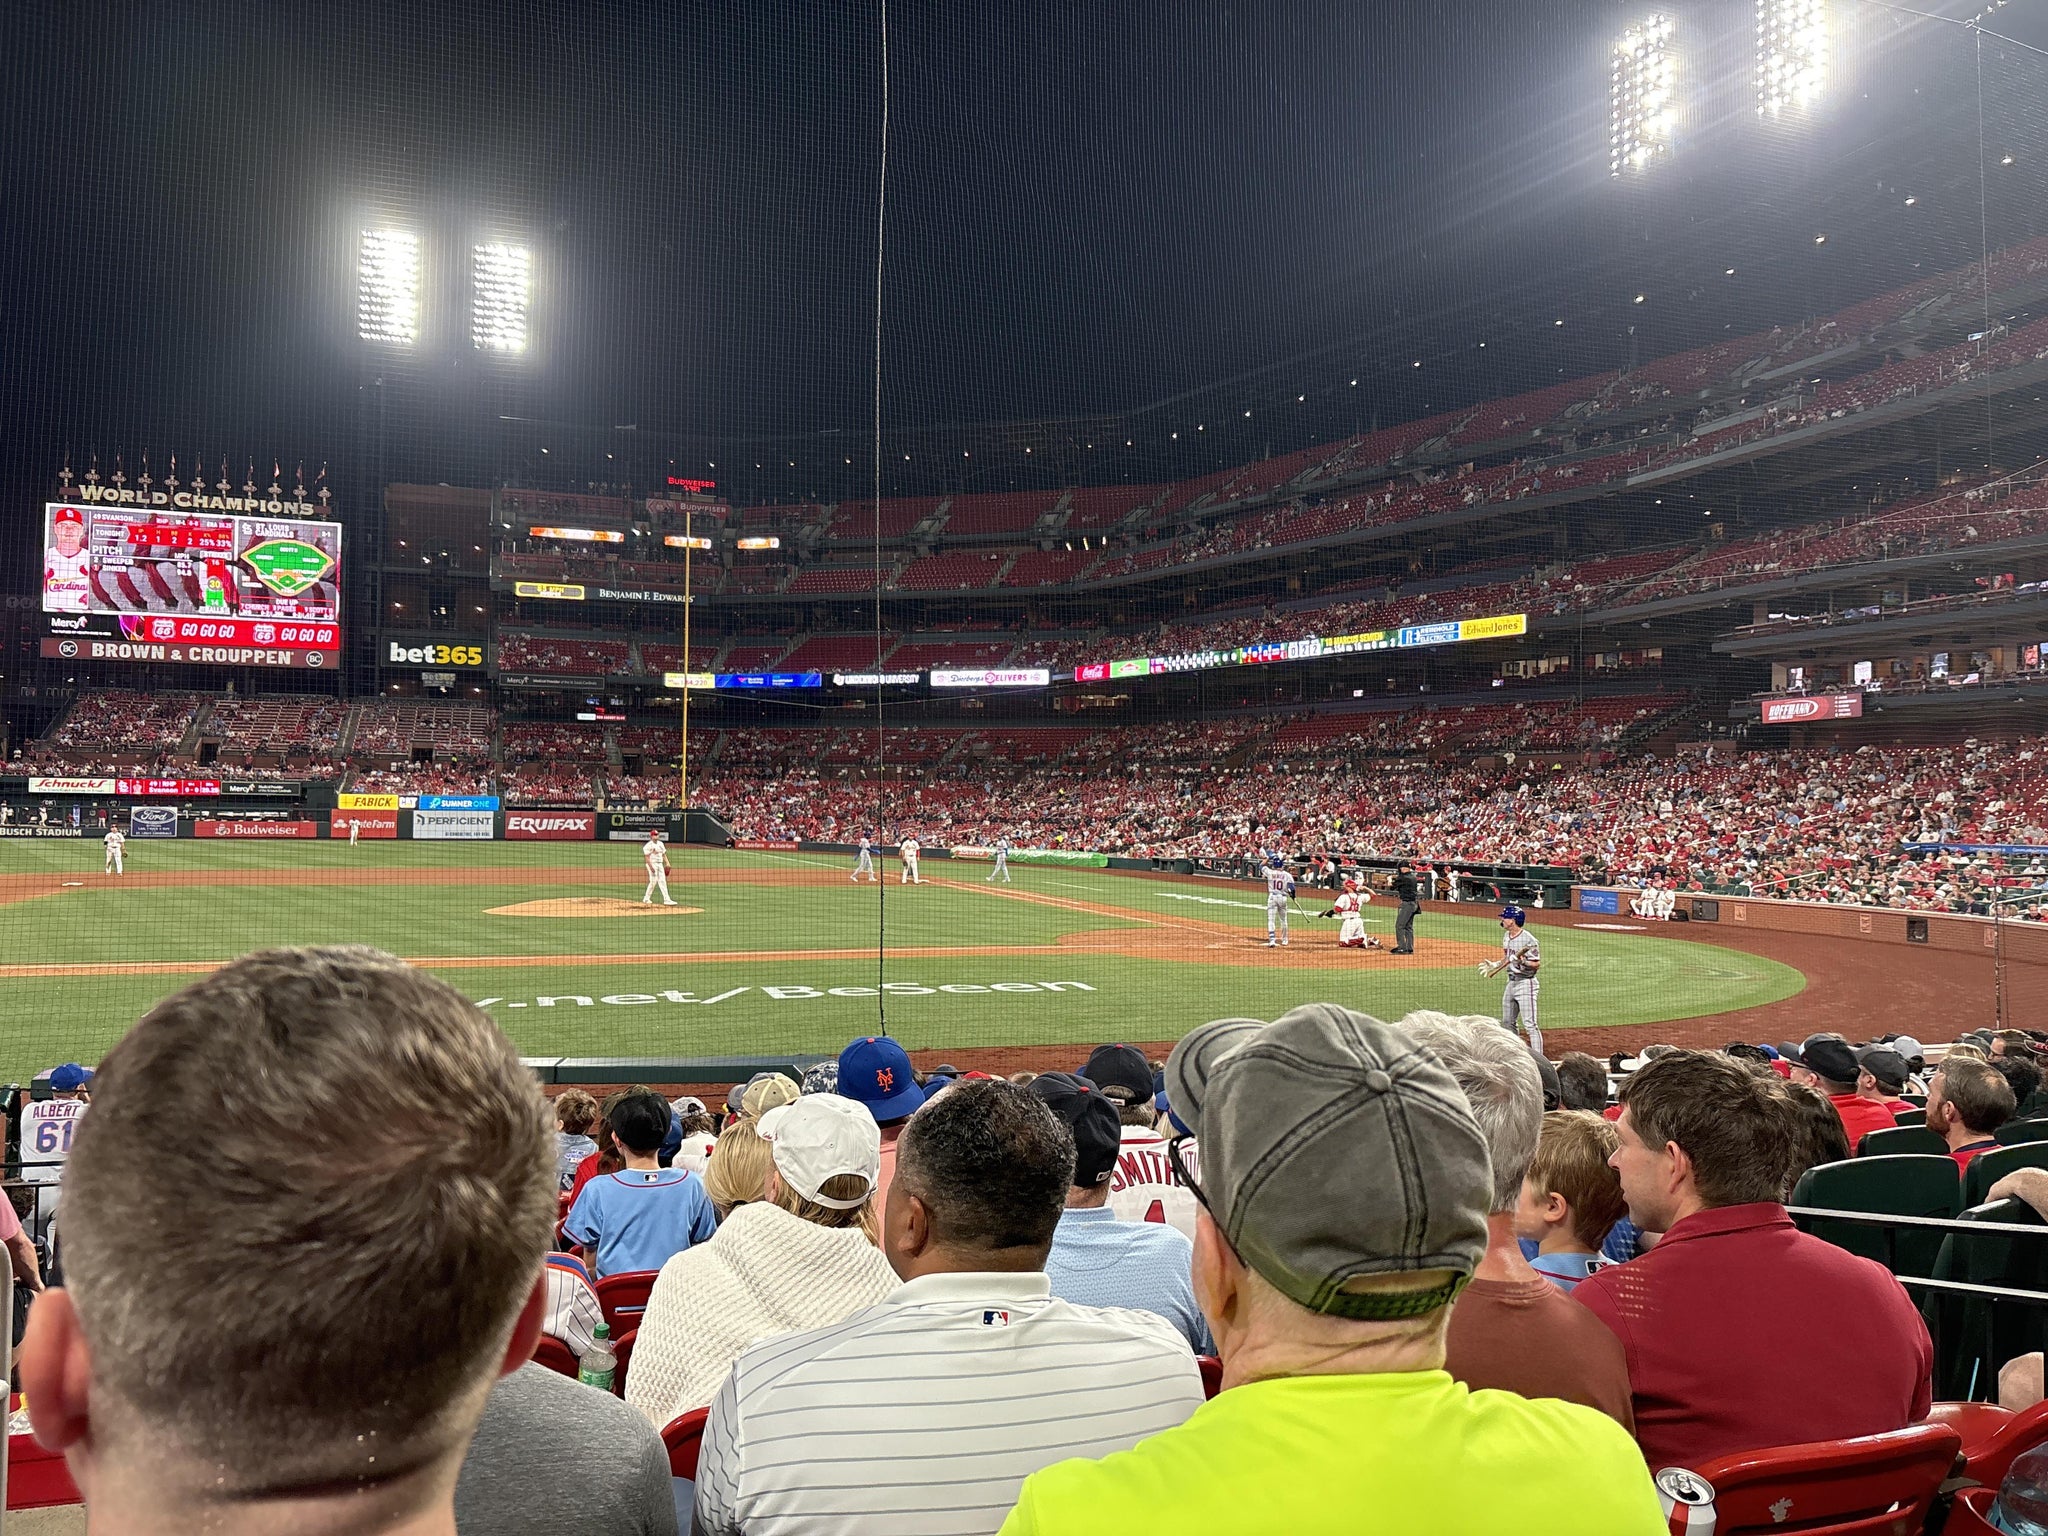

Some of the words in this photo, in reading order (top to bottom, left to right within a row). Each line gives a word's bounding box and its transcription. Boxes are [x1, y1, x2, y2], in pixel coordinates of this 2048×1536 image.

[667, 476, 716, 488] BUDWEISER
[78, 484, 168, 504] WORLD
[173, 492, 315, 516] CHAMPIONS
[680, 502, 727, 514] BUDWEISER
[95, 528, 125, 537] TONIGHT
[268, 523, 290, 532] LOUIS
[255, 529, 294, 539] CARDINALS
[134, 534, 148, 543] 1.2
[155, 535, 161, 543] 1
[171, 536, 178, 545] 2
[187, 537, 193, 545] 2
[199, 538, 216, 547] 25%
[215, 539, 232, 548] 33%
[92, 545, 123, 556] PITCH
[102, 556, 134, 565] SWEEPER
[209, 580, 221, 589] 30
[600, 588, 642, 600] BENJAMIN
[643, 592, 651, 600] F.
[51, 617, 79, 630] Mercy
[156, 628, 171, 636] 66
[181, 623, 198, 637] GO
[200, 624, 216, 638] GO
[218, 625, 235, 639] GO
[281, 628, 297, 641] GO
[299, 629, 314, 642] GO
[316, 629, 332, 643] GO
[62, 644, 76, 653] BC
[91, 642, 165, 660] BROWN
[171, 650, 182, 661] &
[189, 647, 292, 665] CROUPPEN
[389, 641, 483, 666] bet365
[1302, 645, 1307, 655] 2
[1312, 644, 1318, 655] 2
[309, 654, 321, 663] BC
[1768, 702, 1811, 717] HOFFMANN
[34, 778, 108, 788] Schnucks
[229, 785, 249, 794] Mercy
[354, 797, 393, 807] FABICK
[399, 796, 418, 808] CAT
[141, 809, 168, 821] Ford
[429, 817, 492, 826] PERFICIENT
[507, 817, 589, 834] EQUIFAX
[0, 827, 33, 836] BUSCH
[36, 828, 82, 837] STADIUM
[234, 823, 298, 835] Budweiser
[1273, 880, 1283, 891] 10
[33, 1103, 81, 1119] ALBERT
[36, 1120, 73, 1154] 61
